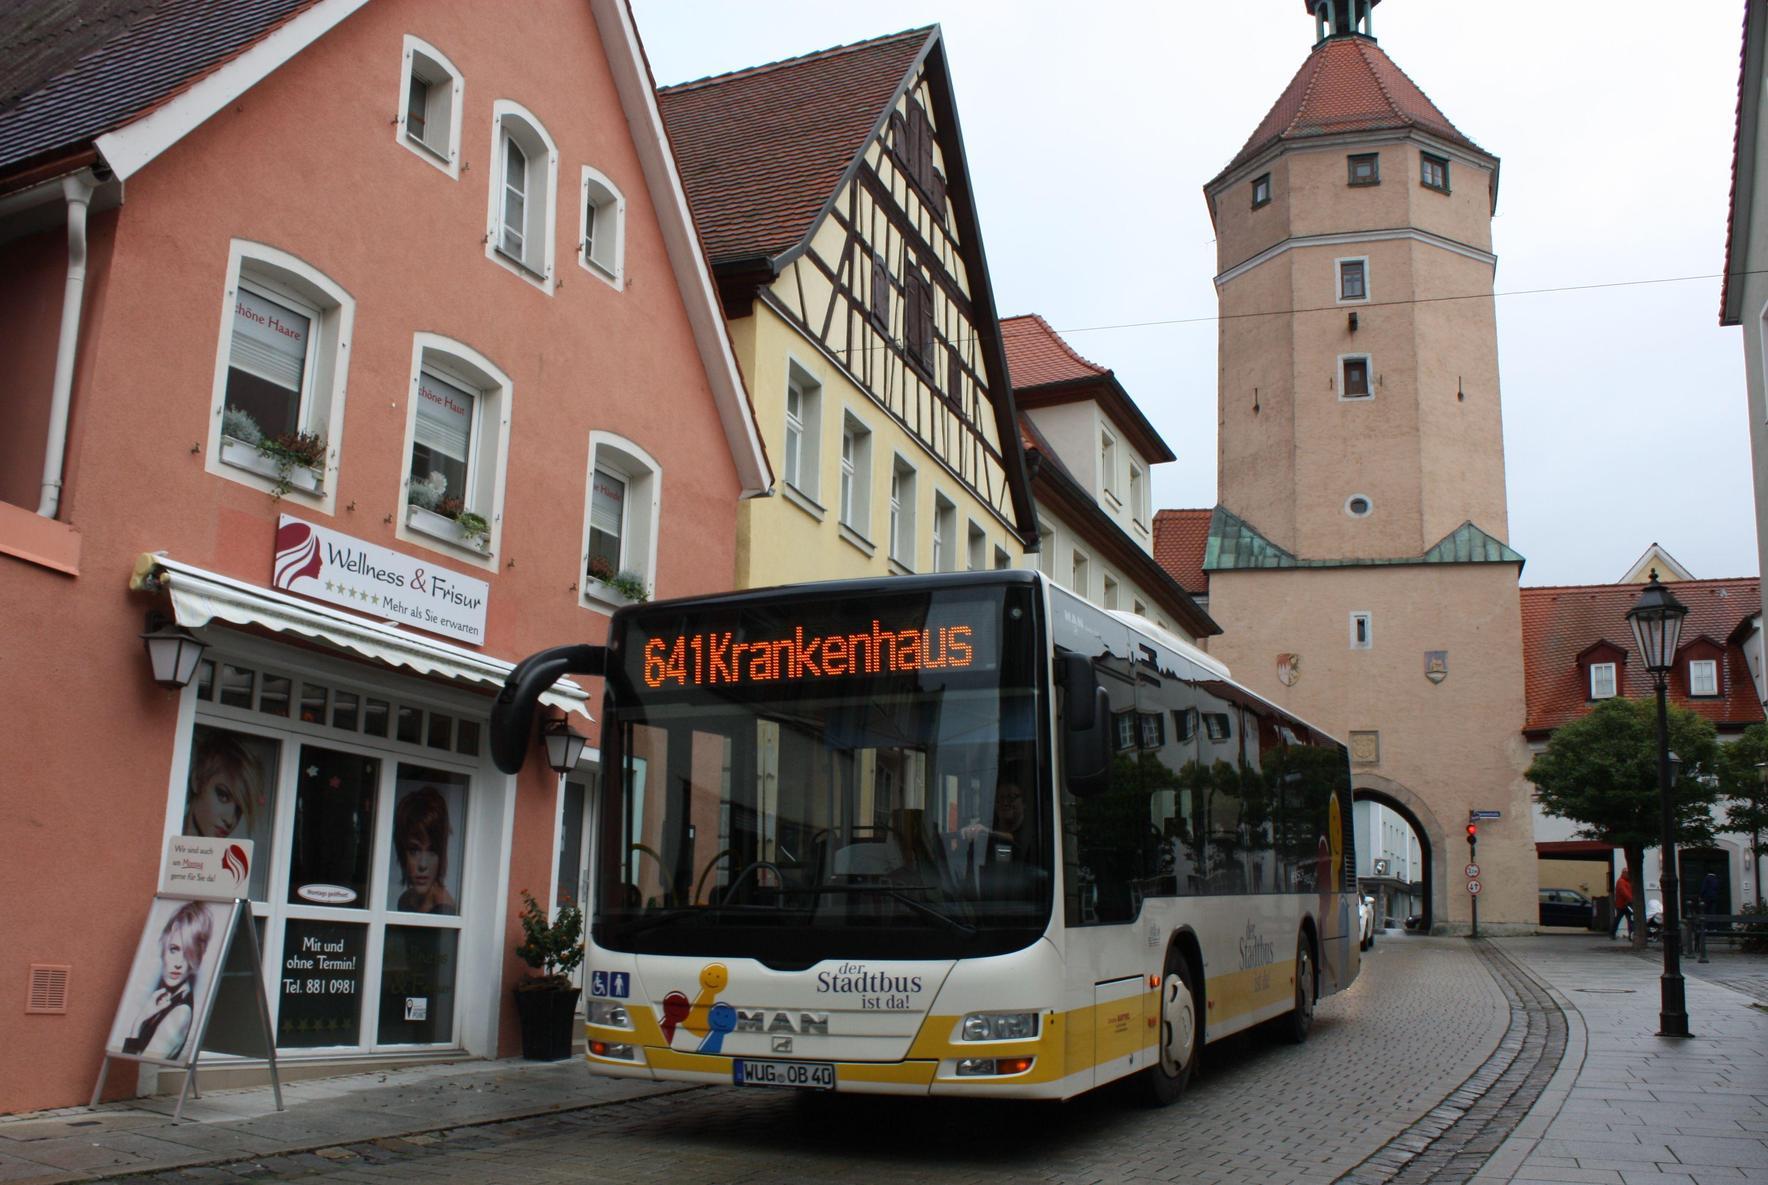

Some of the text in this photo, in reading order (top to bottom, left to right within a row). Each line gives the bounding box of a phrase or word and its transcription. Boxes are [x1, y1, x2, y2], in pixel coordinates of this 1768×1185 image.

[267, 316, 302, 341] Haare
[444, 395, 465, 417] Haut
[327, 541, 482, 610] Wellness & Frisur
[382, 596, 480, 636] Mehr als Sie erwarten
[199, 846, 214, 855] auch
[197, 872, 206, 882] Sie
[302, 936, 344, 953] Mit und
[1239, 934, 1274, 970] Stadtbus
[286, 954, 357, 971] ohne Termin!
[838, 962, 866, 975] der
[283, 978, 355, 994] Tel. 881 0981
[816, 971, 922, 993] Stadtbus
[861, 994, 910, 1010] ist da!
[736, 1009, 830, 1035] MAN
[744, 1062, 832, 1086] WUG OB 40
